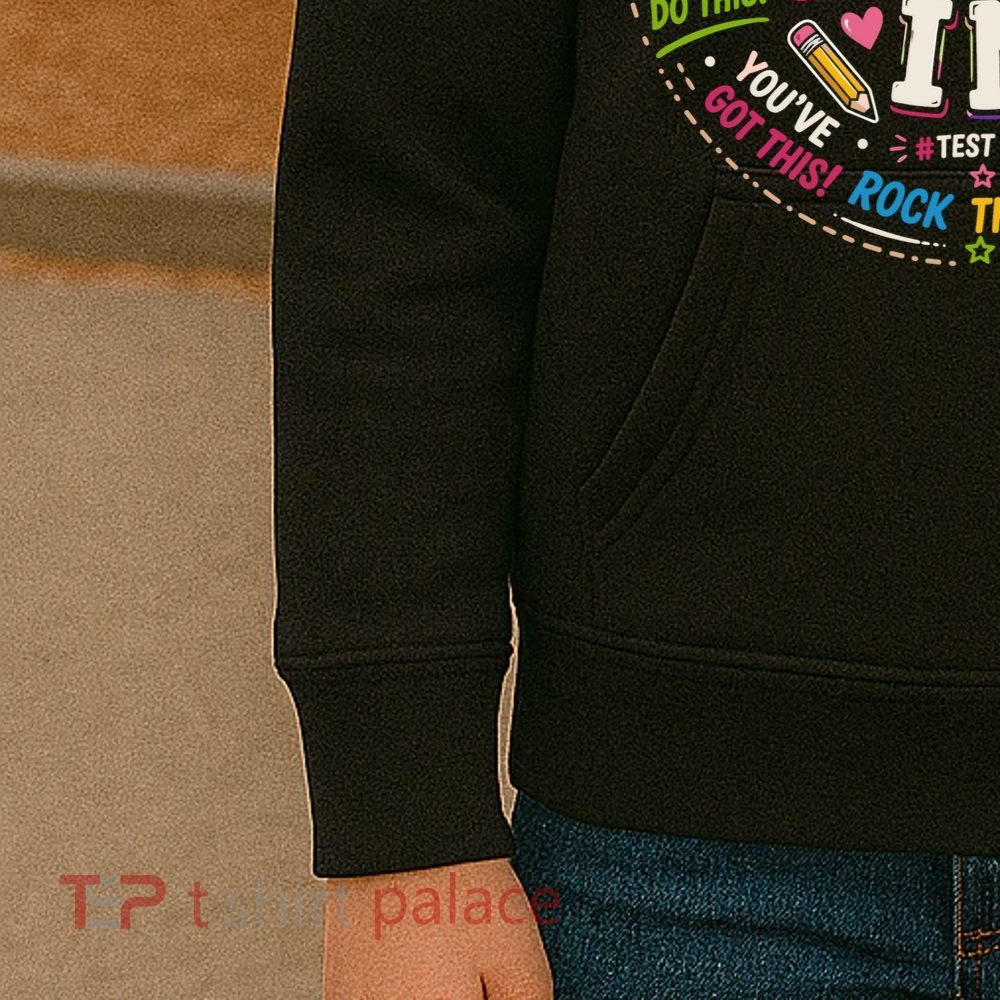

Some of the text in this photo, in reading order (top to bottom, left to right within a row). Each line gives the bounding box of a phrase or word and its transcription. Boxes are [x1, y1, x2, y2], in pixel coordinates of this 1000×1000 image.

[704, 84, 843, 198] GOT THIS!
[736, 50, 840, 148] YOU'VE
[847, 170, 955, 231] ROCK
